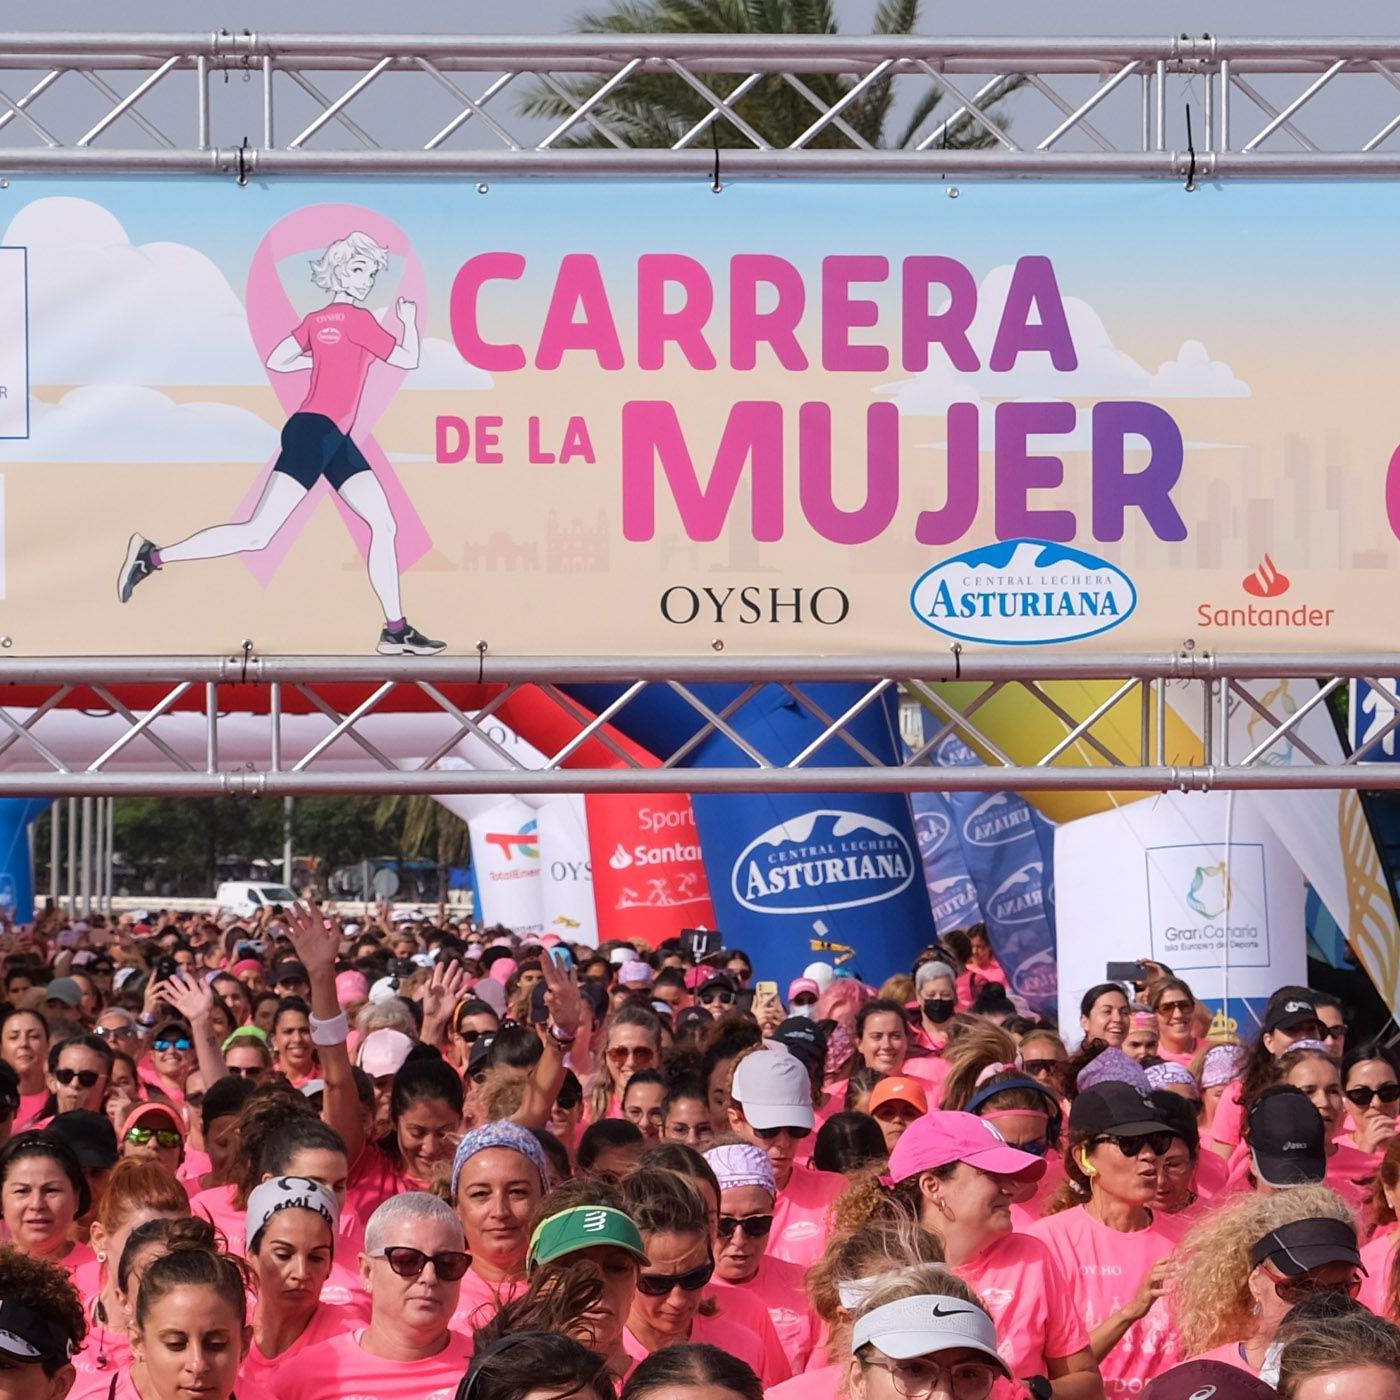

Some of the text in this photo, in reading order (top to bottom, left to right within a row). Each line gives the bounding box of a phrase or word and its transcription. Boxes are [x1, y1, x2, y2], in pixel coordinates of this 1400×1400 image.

[449, 251, 1079, 373] CARRERA
[435, 415, 596, 465] DE LA
[622, 401, 1188, 545] MUJER
[928, 578, 1119, 618] ASTURIANA
[962, 574, 1112, 587] CENTRAL LECHERA
[660, 585, 850, 625] OYSHO
[1197, 604, 1334, 628] Santander
[637, 807, 696, 833] Sport
[767, 844, 835, 865] CENTRAL
[745, 850, 908, 900] ASTURIANA
